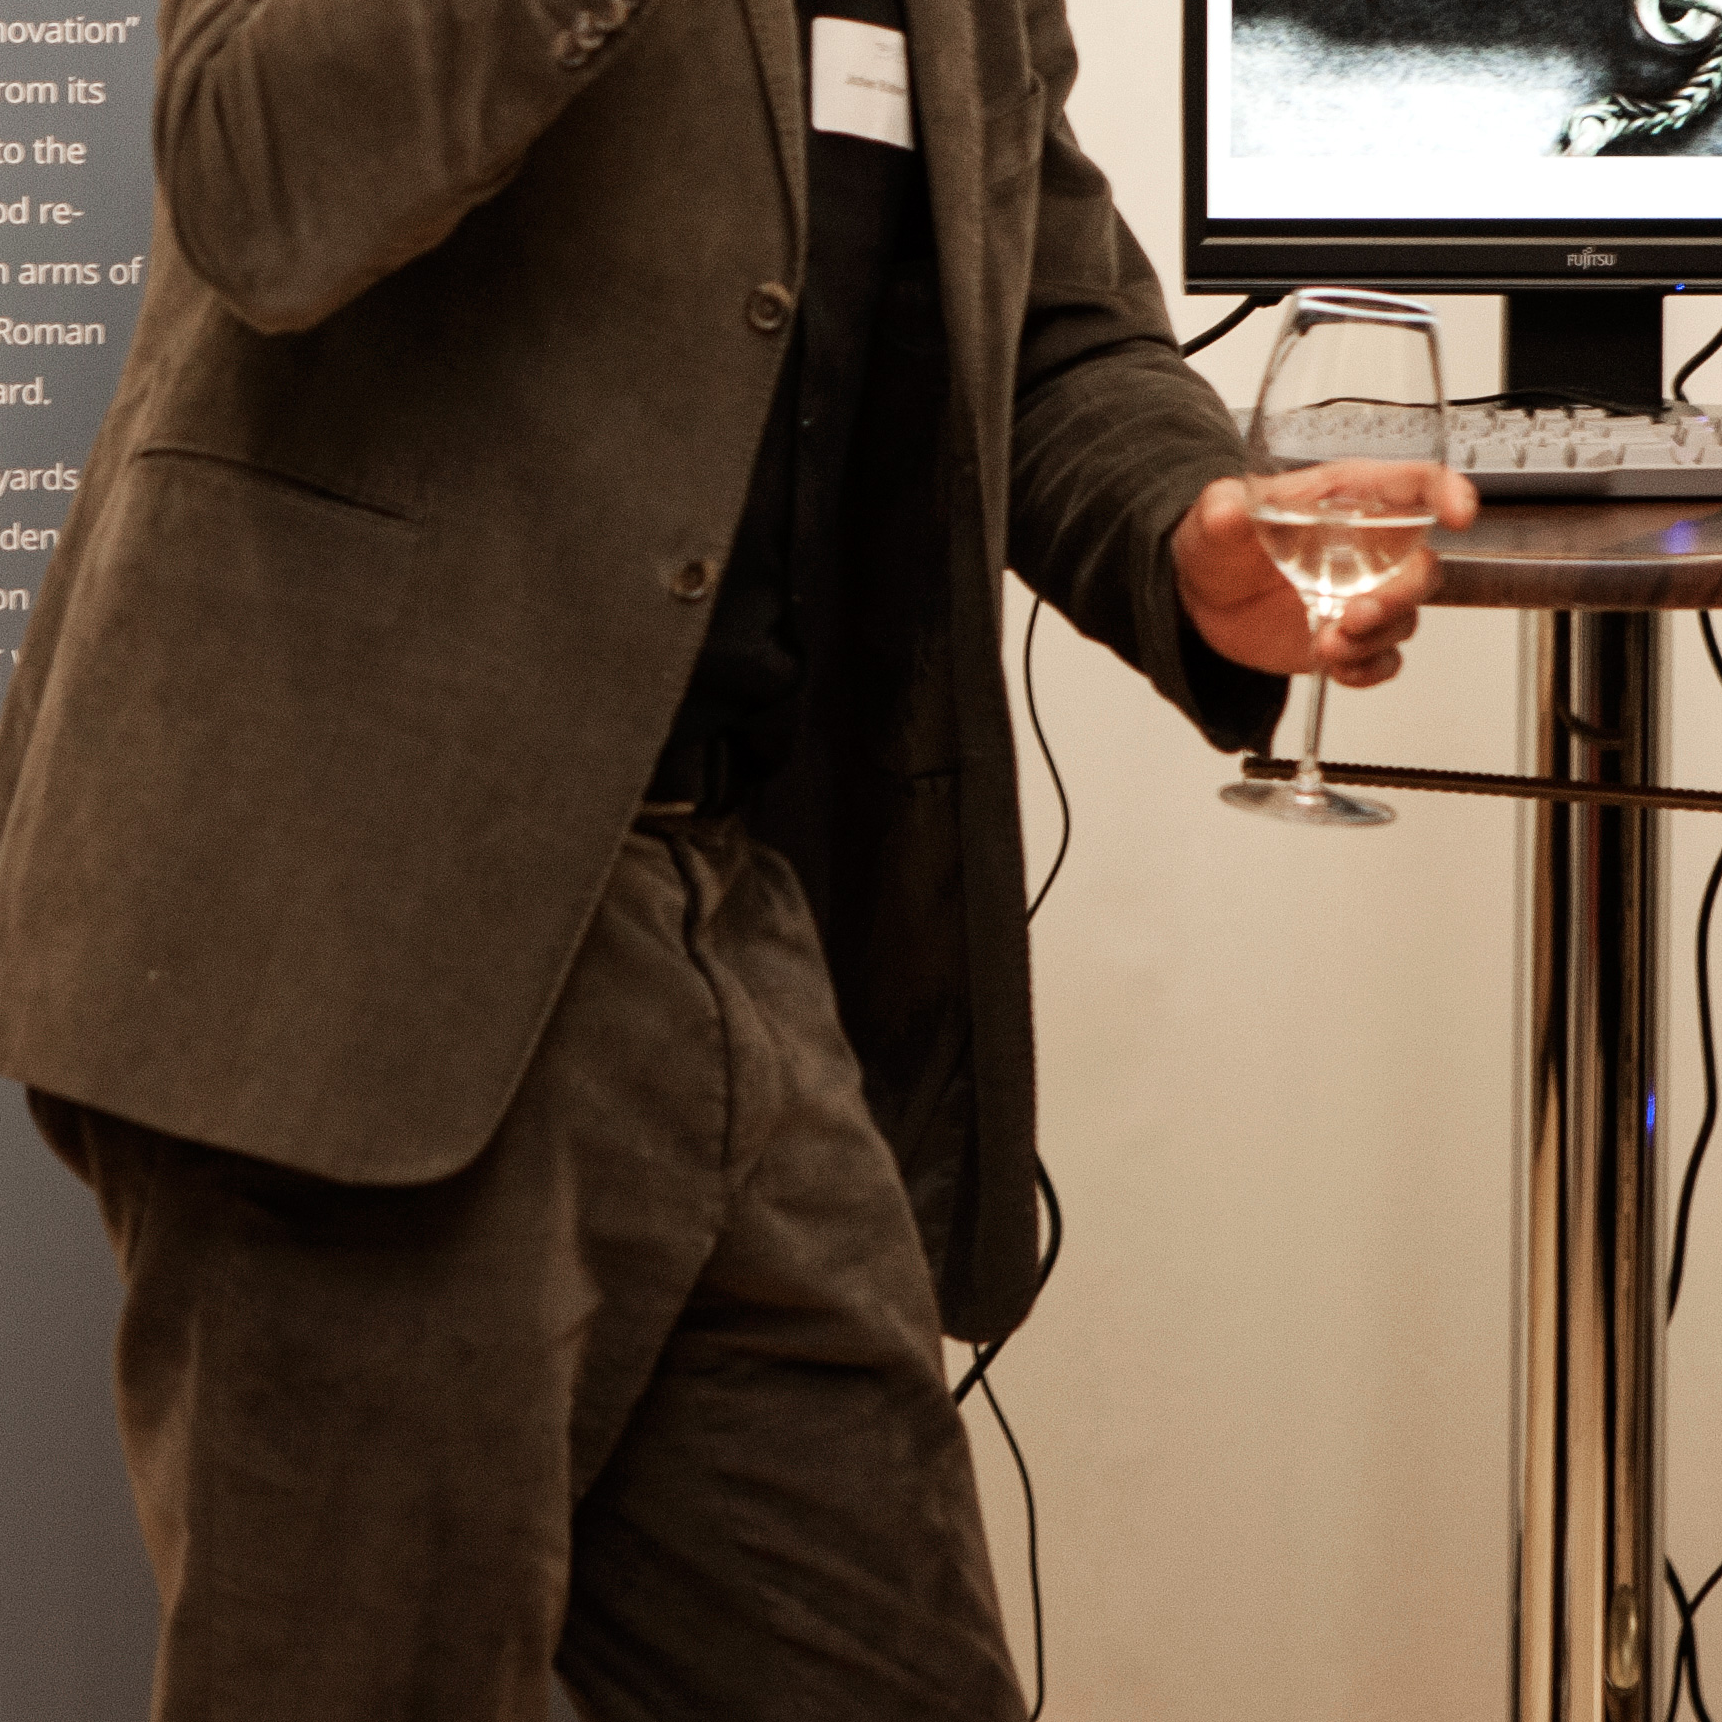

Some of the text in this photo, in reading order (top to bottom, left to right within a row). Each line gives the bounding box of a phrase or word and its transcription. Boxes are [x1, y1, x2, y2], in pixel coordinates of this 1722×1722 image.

[68, 75, 108, 105] its
[33, 135, 88, 166] the
[39, 202, 84, 226] re-
[18, 262, 102, 286] arms
[109, 255, 144, 286] of
